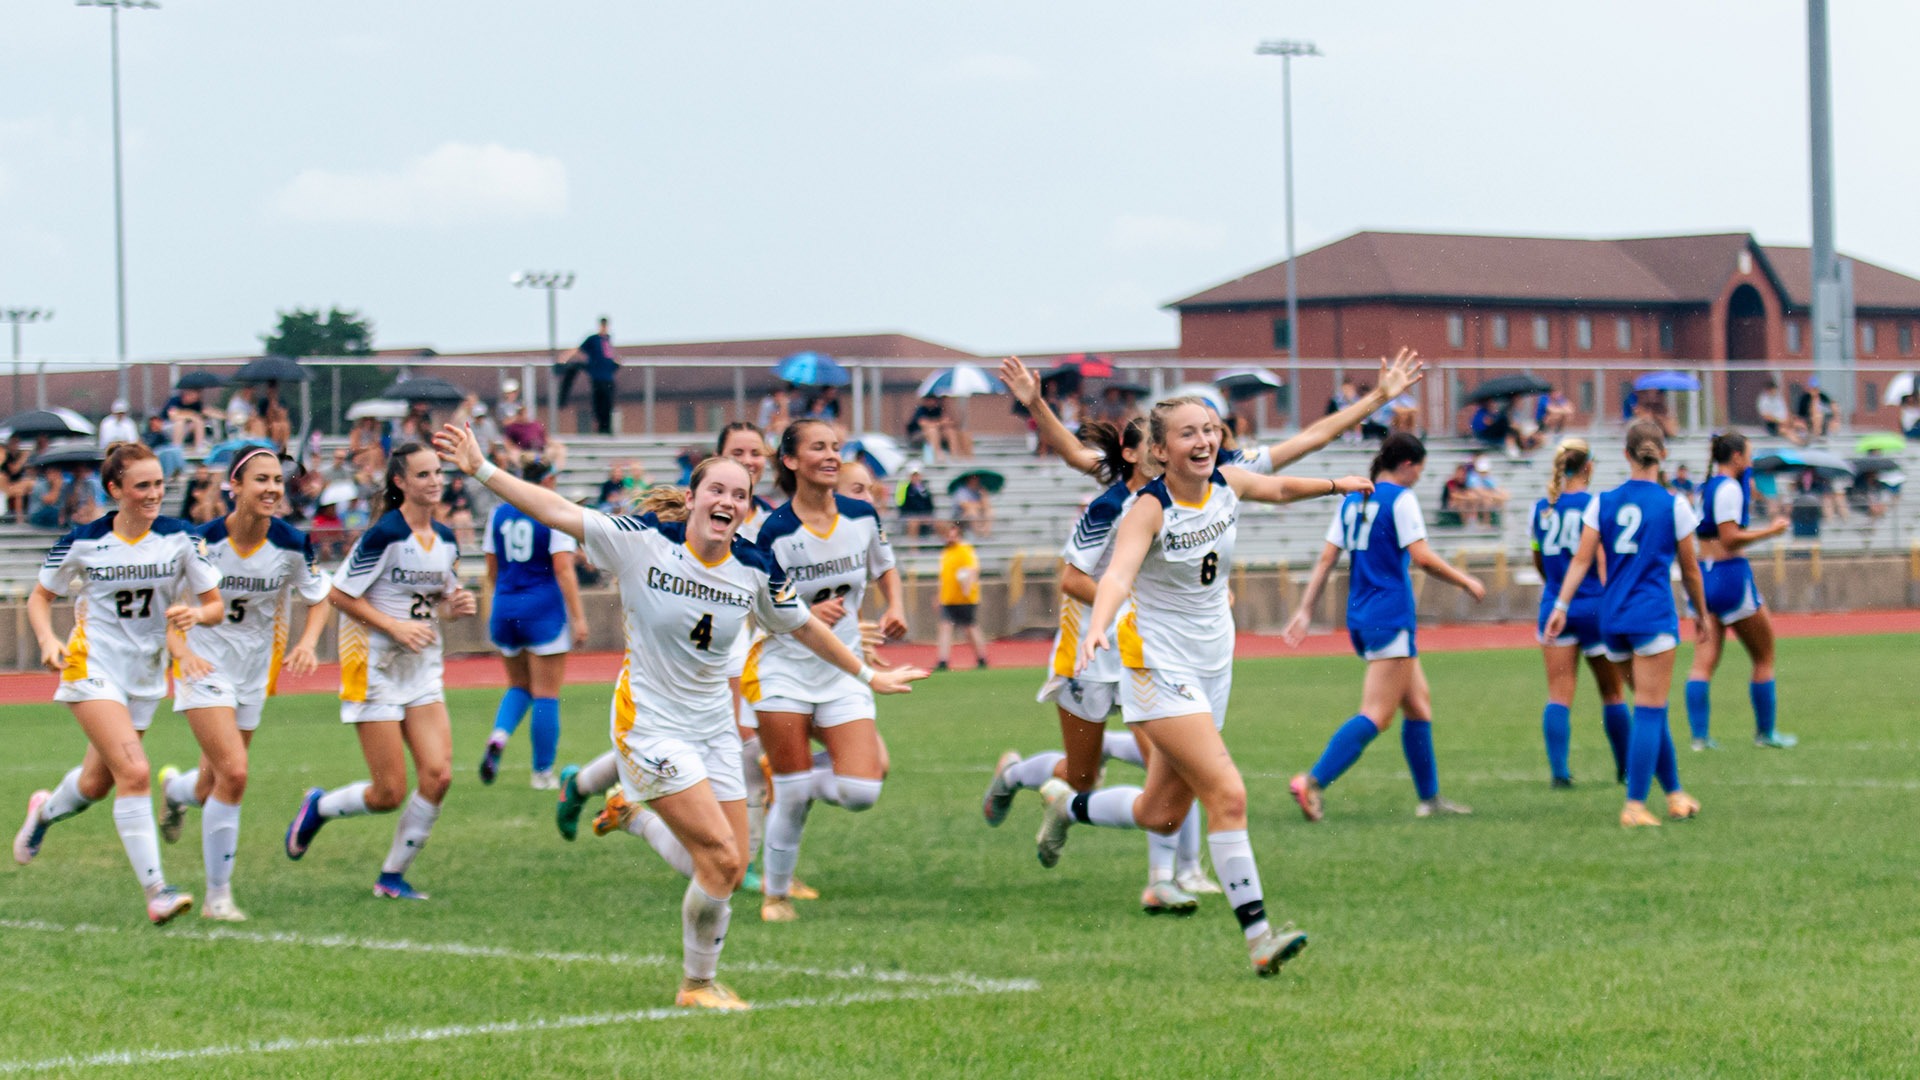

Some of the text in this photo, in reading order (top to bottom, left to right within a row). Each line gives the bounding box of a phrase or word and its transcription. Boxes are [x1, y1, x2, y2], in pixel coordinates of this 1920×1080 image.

[500, 518, 534, 562] 19
[1344, 502, 1380, 551] 17
[1540, 508, 1582, 556] 24
[1615, 503, 1642, 554] 2
[1201, 552, 1218, 586] 6
[115, 588, 154, 619] 27
[227, 598, 249, 624] 5
[690, 613, 713, 651] 4
